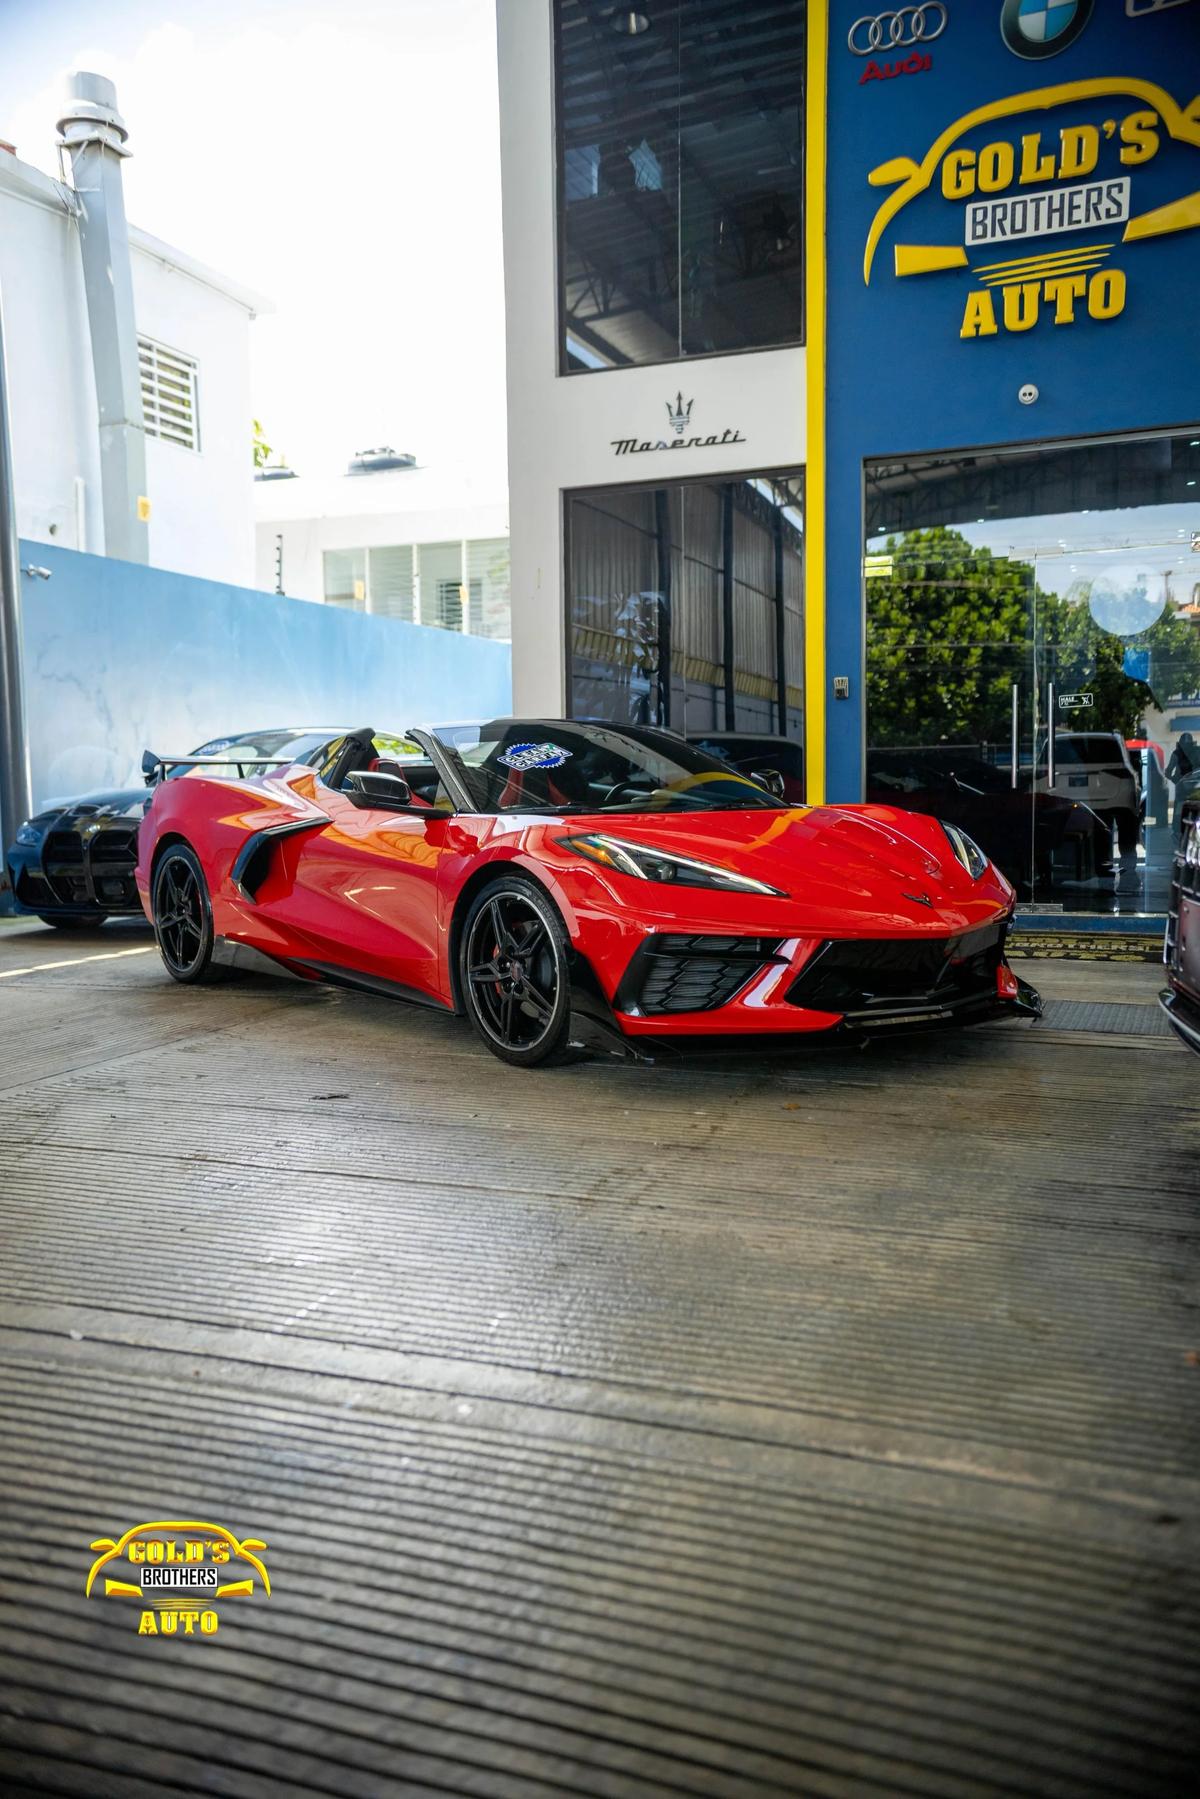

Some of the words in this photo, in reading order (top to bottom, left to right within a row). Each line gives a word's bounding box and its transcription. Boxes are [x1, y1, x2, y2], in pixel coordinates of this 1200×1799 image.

[859, 51, 932, 85] Audi
[942, 111, 1160, 199] GOLD'S
[971, 182, 1124, 241] BROTHERS
[960, 269, 1126, 338] AUTO
[611, 429, 746, 455] Maserati
